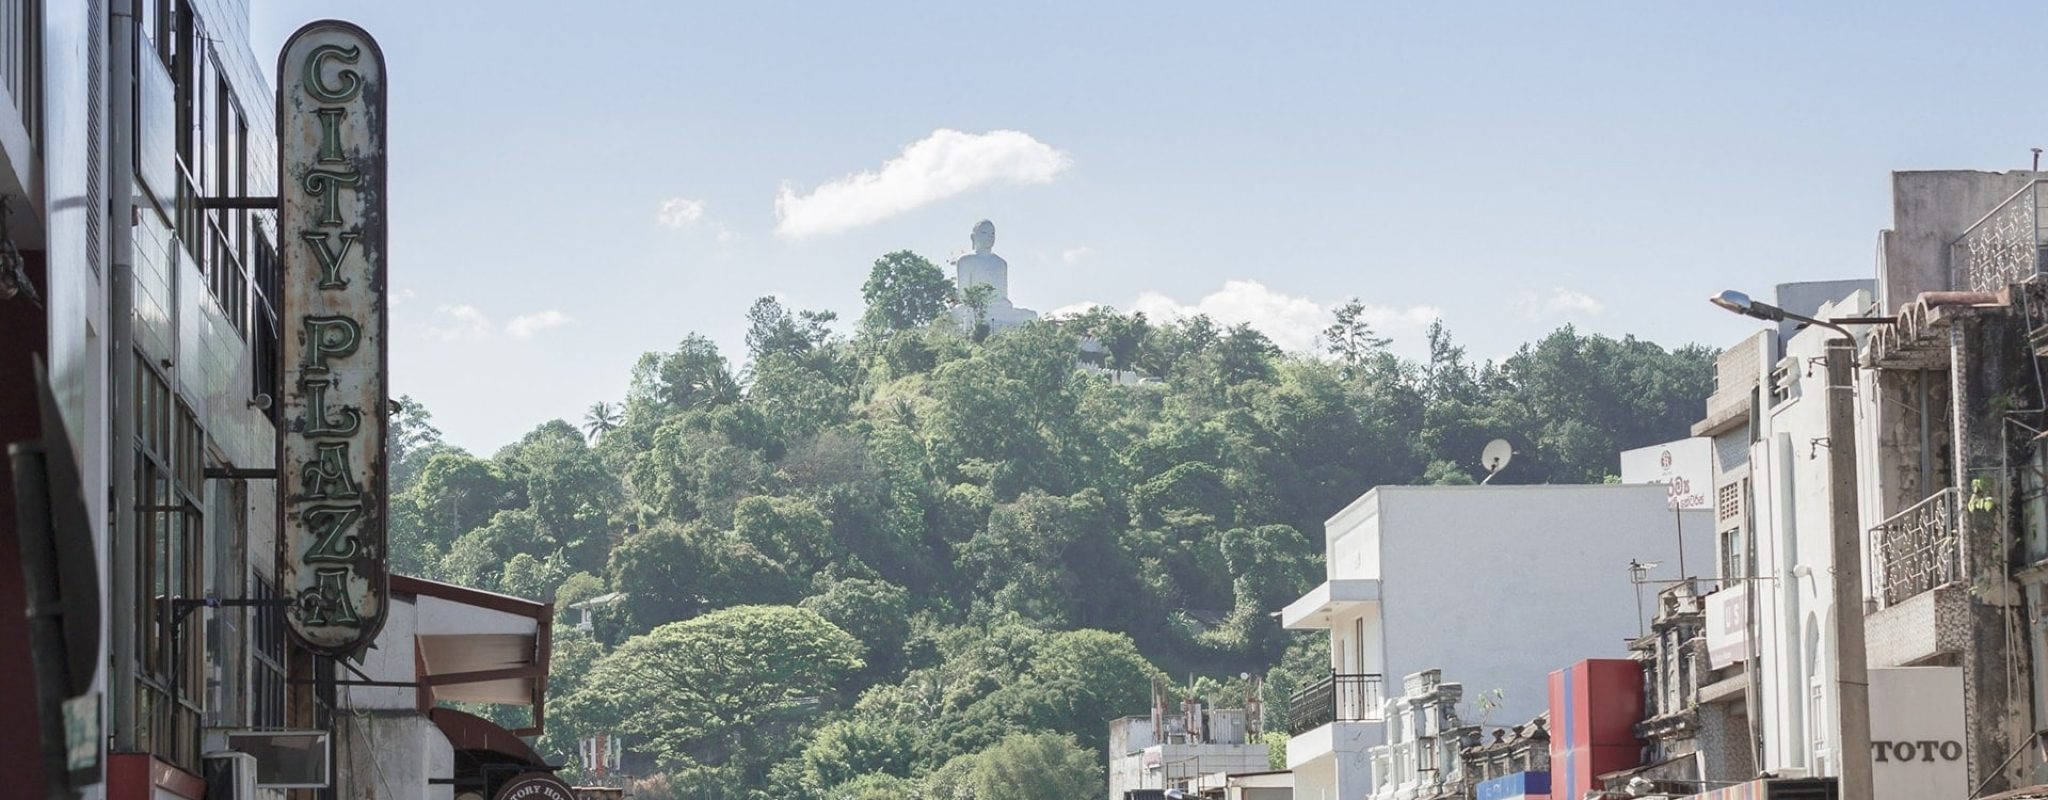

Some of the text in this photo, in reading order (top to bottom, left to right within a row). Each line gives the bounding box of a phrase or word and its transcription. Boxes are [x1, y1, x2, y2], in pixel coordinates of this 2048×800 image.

[302, 44, 362, 627] CITY PLAZA
[1871, 741, 1962, 762] TOTO
[544, 787, 565, 800] HO
